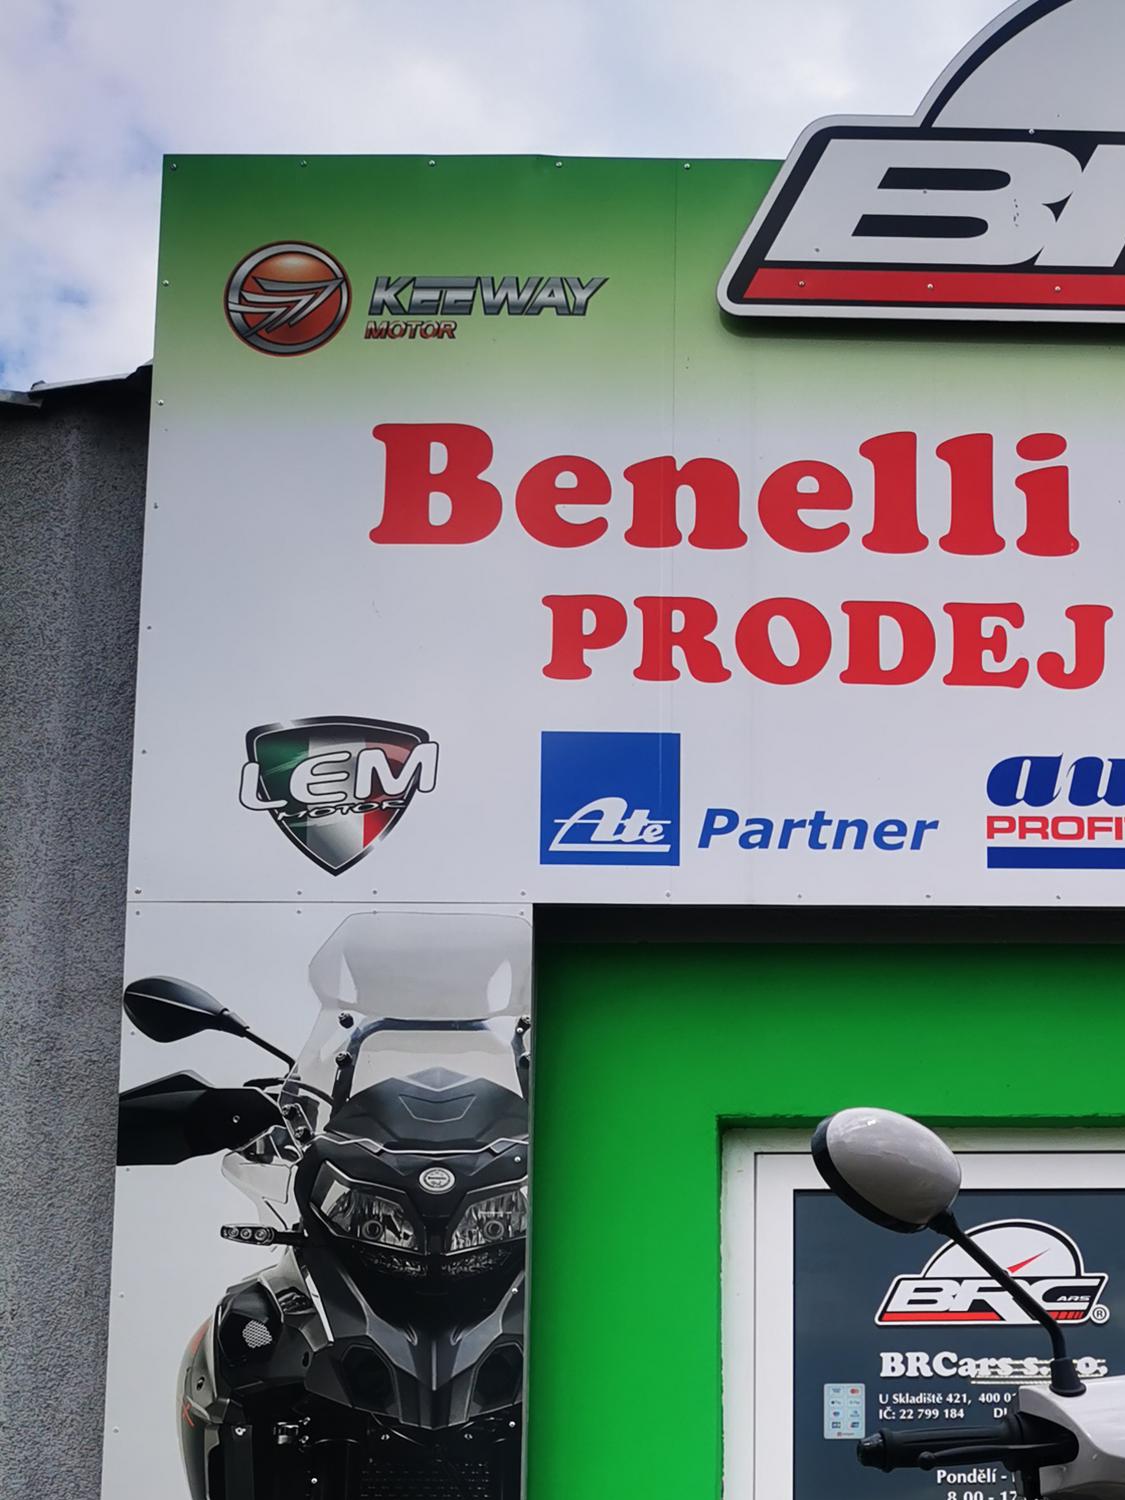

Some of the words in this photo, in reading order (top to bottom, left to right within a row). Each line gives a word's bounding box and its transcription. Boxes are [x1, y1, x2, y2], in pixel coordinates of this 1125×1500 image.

[370, 275, 610, 317] KEEWAY
[364, 320, 458, 340] MOTOR
[369, 423, 1080, 557] Benelli
[541, 593, 1114, 690] PRODEJ
[239, 741, 440, 811] LEM
[277, 799, 407, 821] MOTOR
[698, 806, 940, 852] Partner
[879, 1351, 1013, 1378] BRCars
[878, 1394, 889, 1404] U
[891, 1392, 943, 1404] Skladiště
[946, 1393, 972, 1406] 421,
[978, 1392, 1000, 1404] 400
[1003, 1392, 1017, 1404] 0
[899, 1408, 914, 1419] 22
[917, 1408, 940, 1419] 799
[944, 1408, 965, 1419] 184
[936, 1468, 998, 1484] Pondělí
